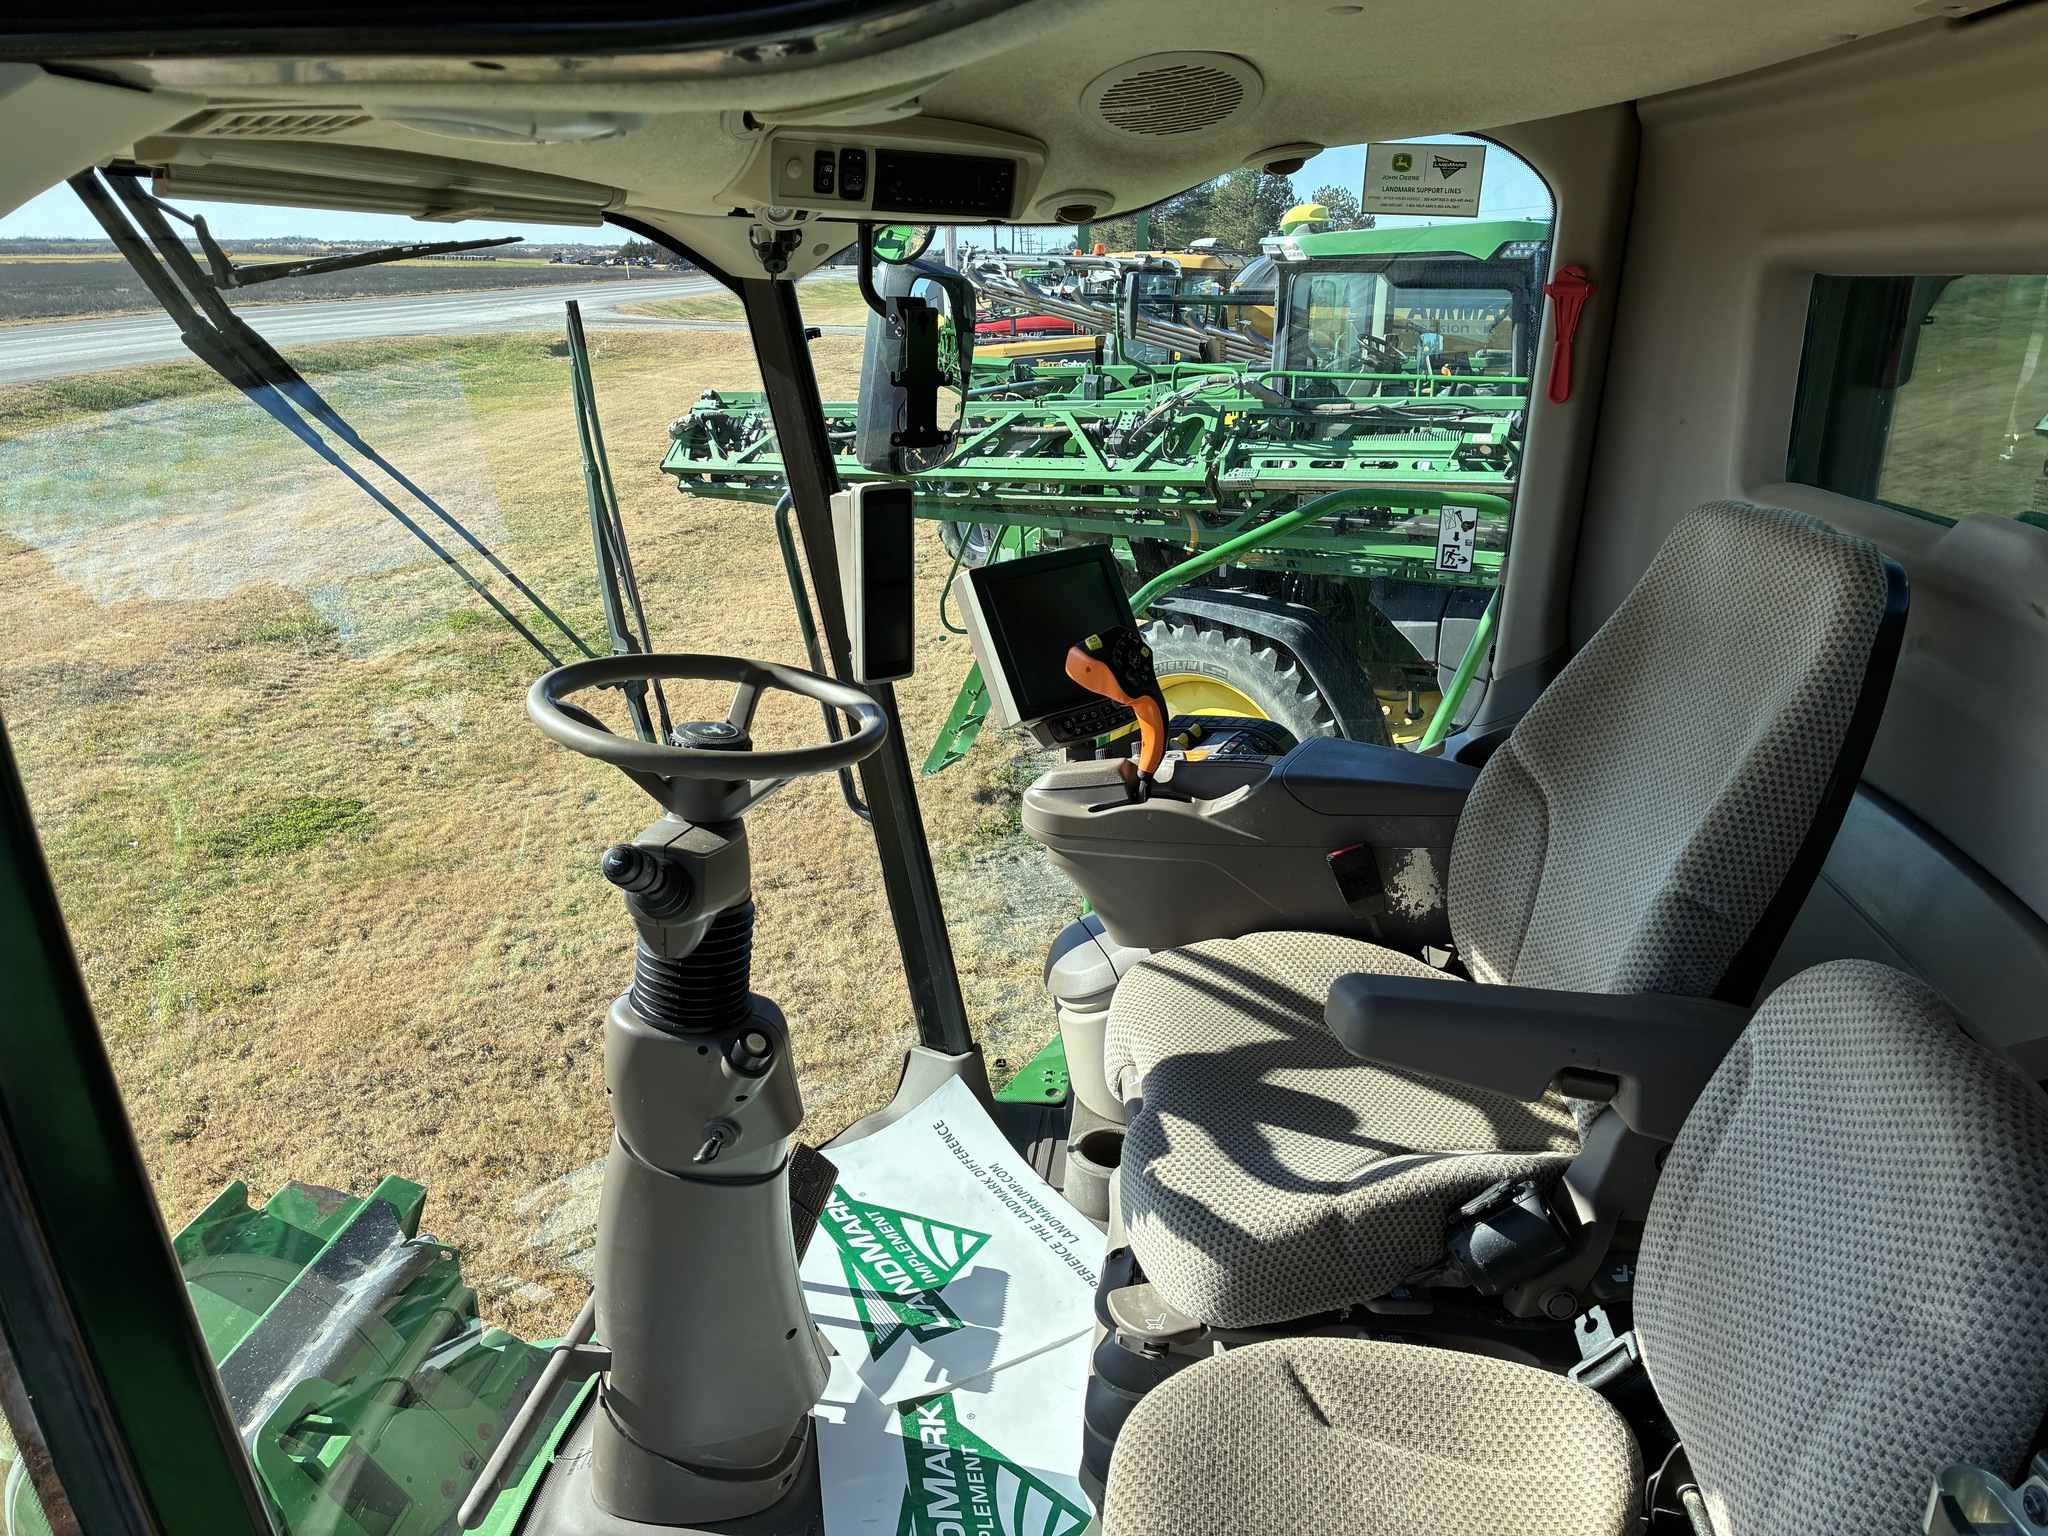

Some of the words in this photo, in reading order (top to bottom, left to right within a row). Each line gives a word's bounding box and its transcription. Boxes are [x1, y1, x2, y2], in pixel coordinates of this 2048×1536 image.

[1444, 187, 1462, 195] LINES
[1406, 321, 1470, 334] Precision
[932, 1119, 987, 1178] DIFFERENCE
[981, 1177, 1036, 1224] LANDMARK
[988, 1162, 1080, 1245] LANDMARKIMP.COM
[865, 1211, 940, 1284] IMPLEMENT
[1029, 1223, 1051, 1243] THE
[826, 1190, 952, 1332] LANDMARK
[1049, 1241, 1099, 1290] PERIENCE
[960, 1444, 995, 1536] LEMENT
